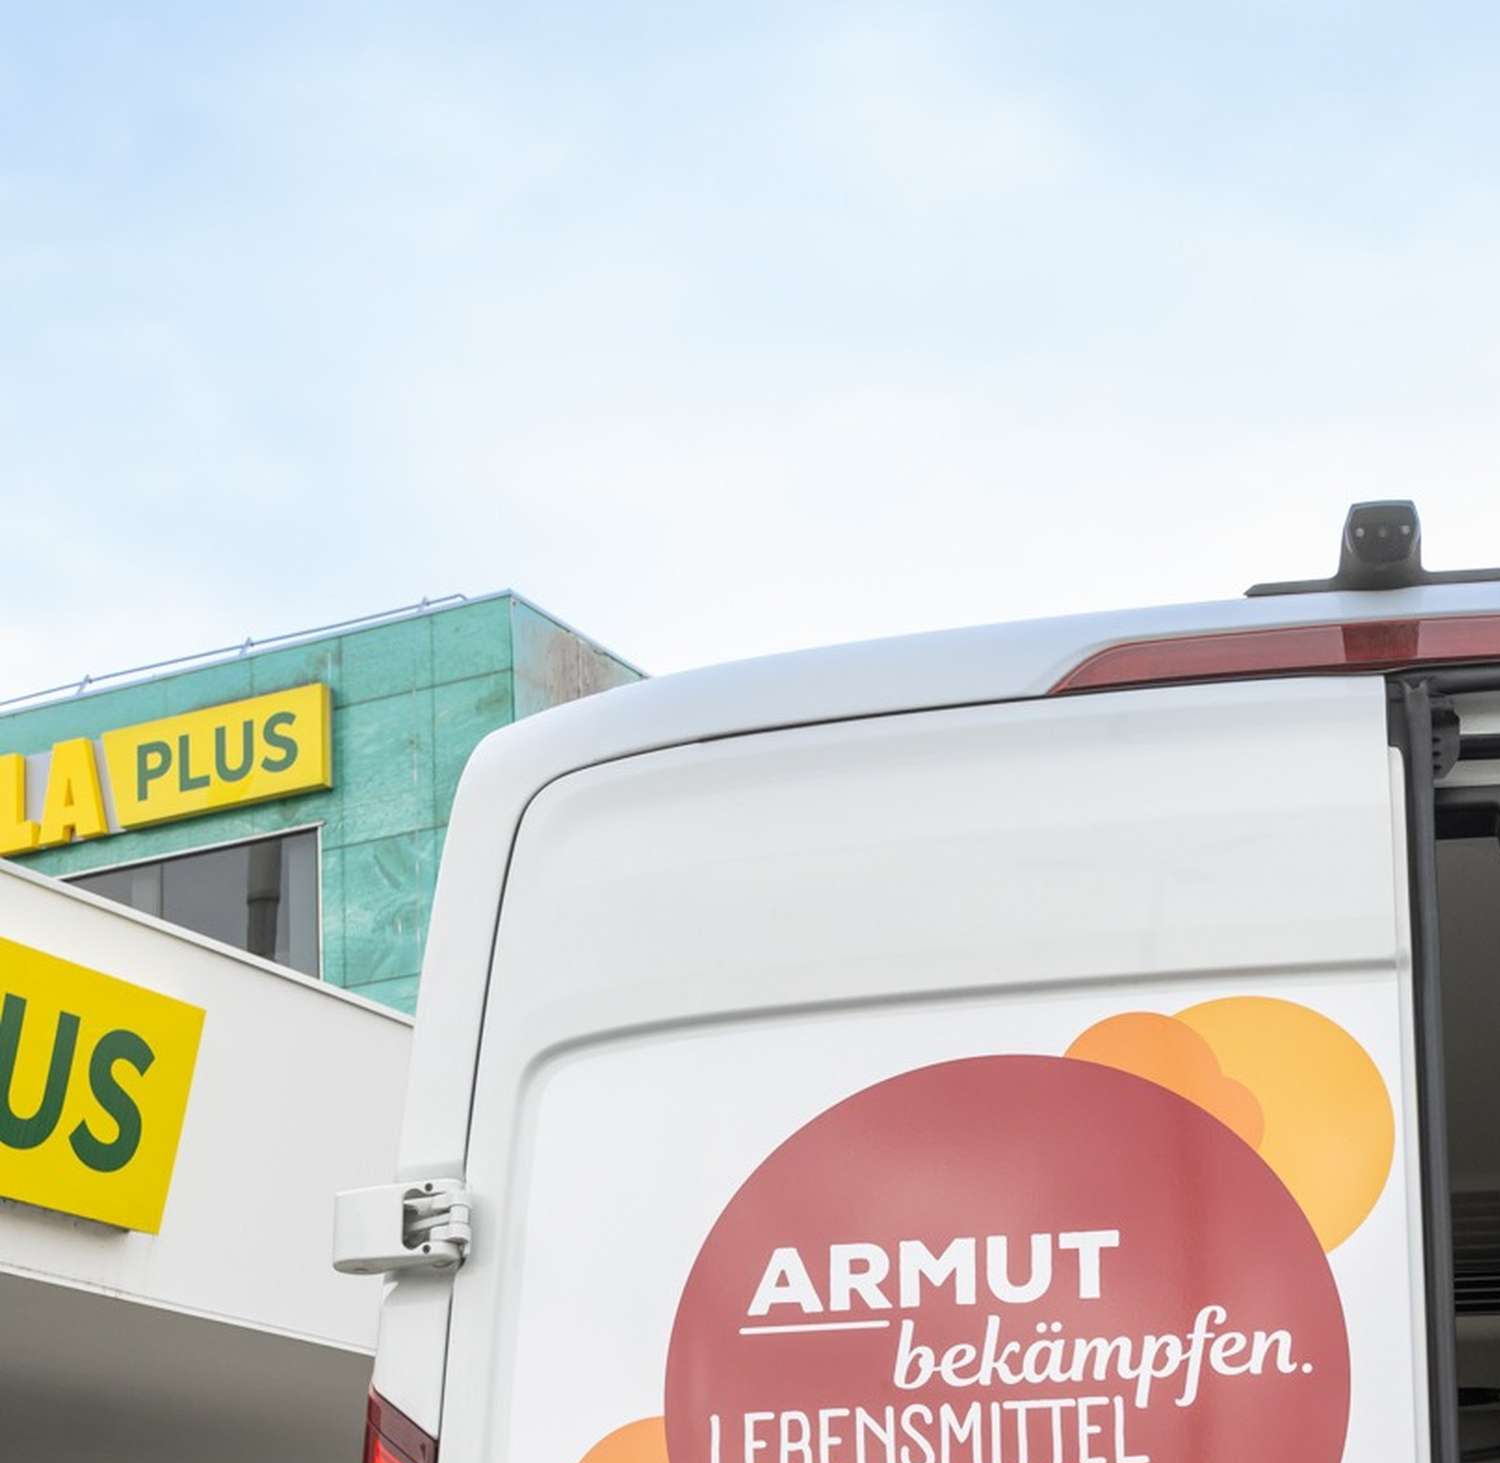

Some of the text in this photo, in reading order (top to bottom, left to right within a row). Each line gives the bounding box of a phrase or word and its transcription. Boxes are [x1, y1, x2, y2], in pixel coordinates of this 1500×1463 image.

[137, 711, 298, 802] PLUS
[0, 992, 156, 1173] US
[747, 1229, 1120, 1317] ARMUT
[892, 1305, 1314, 1408] bekämpfen.
